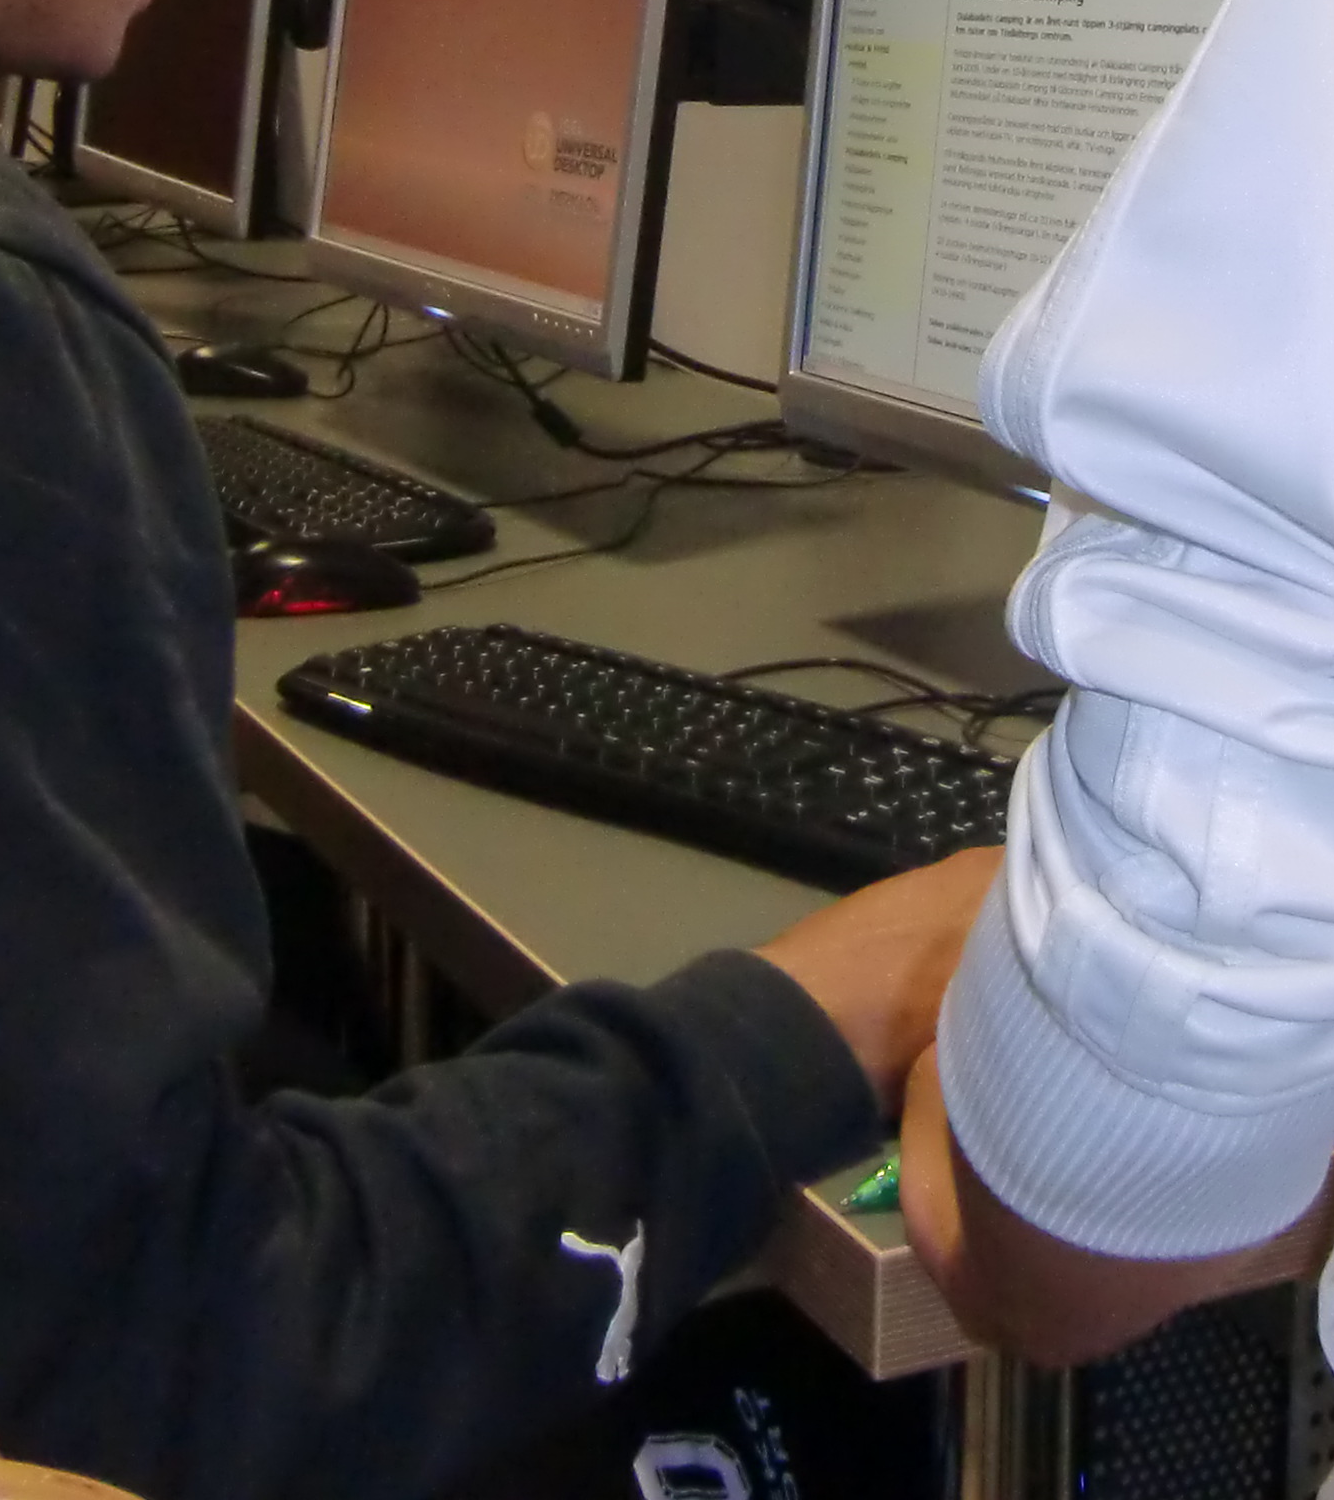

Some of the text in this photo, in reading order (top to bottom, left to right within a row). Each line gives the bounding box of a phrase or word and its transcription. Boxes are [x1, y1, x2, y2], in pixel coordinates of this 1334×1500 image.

[995, 15, 1024, 26] camping
[1147, 23, 1200, 36] campingplats
[555, 137, 618, 164] UNIVERSAL
[553, 154, 606, 181] DESKTOP
